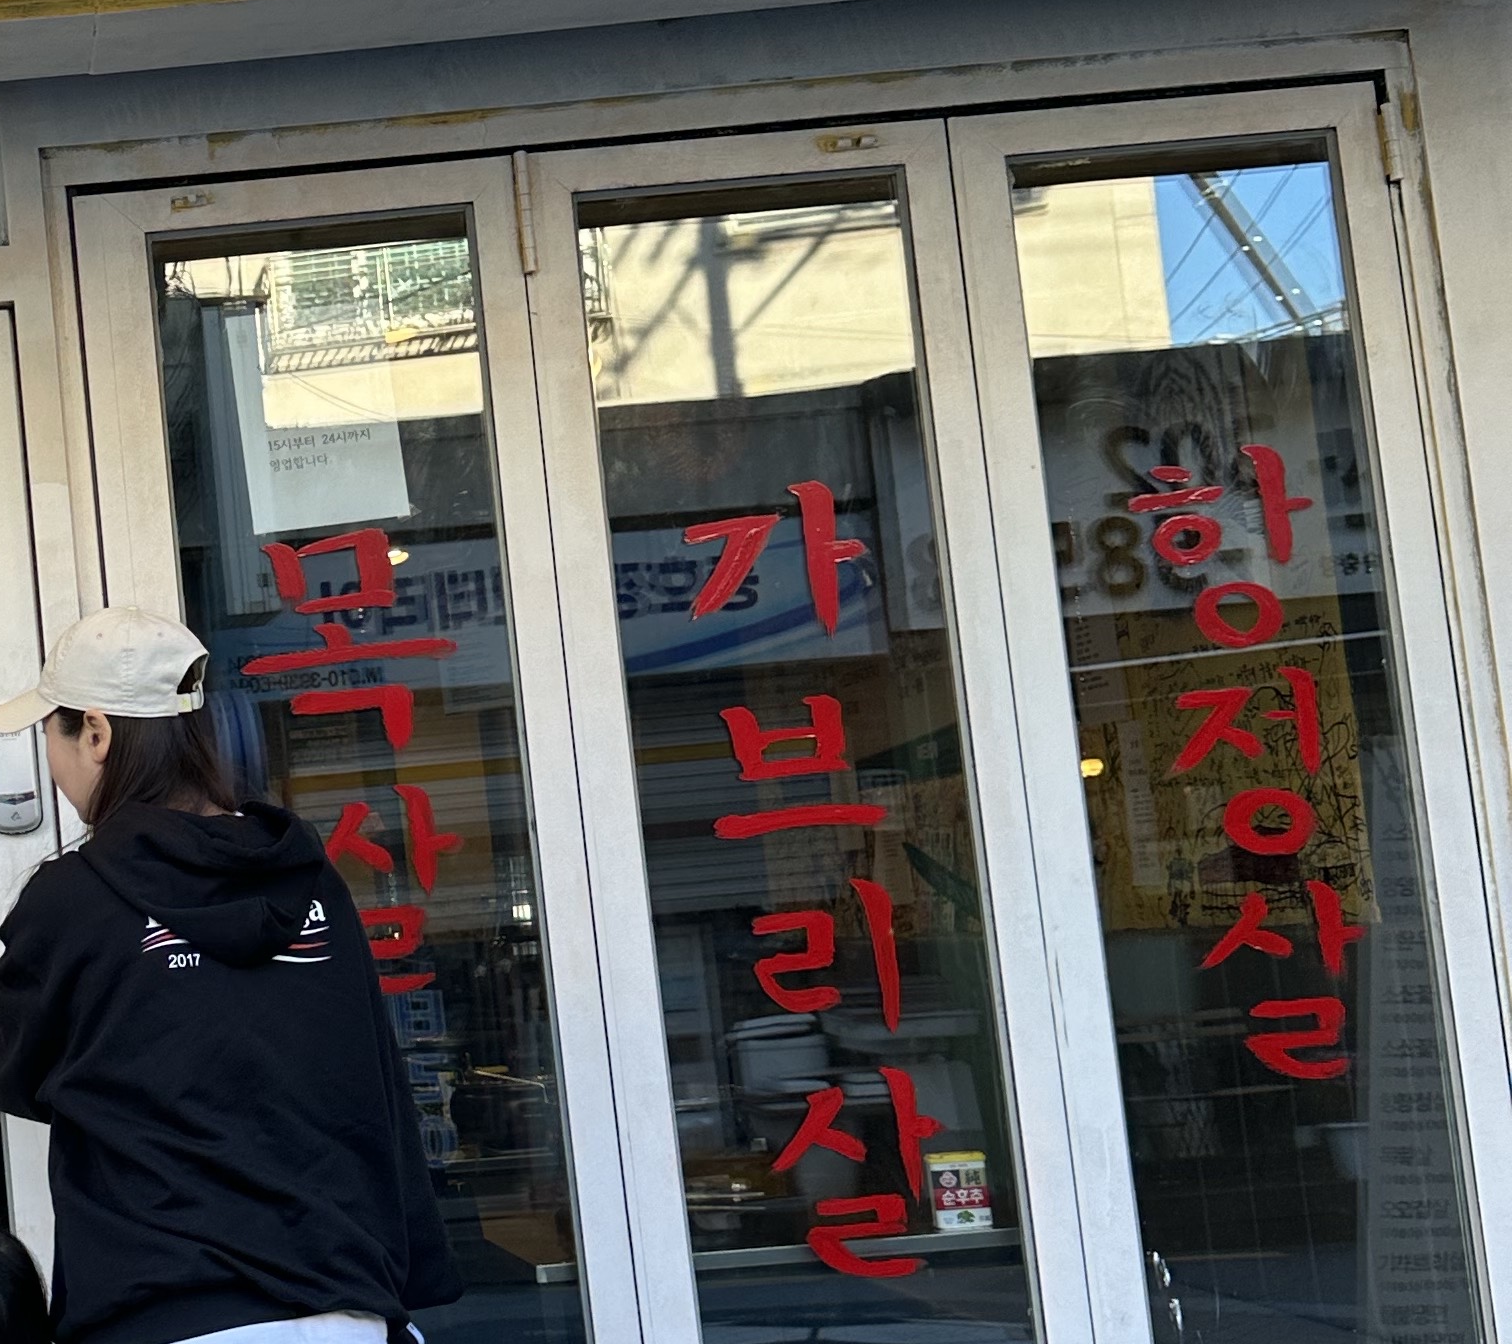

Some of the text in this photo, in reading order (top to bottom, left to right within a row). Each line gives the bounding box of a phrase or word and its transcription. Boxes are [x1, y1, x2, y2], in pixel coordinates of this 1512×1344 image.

[268, 428, 371, 451] 15시부터 24시까지
[243, 528, 463, 993] 목살
[685, 481, 943, 1277] 가브리살
[1129, 445, 1364, 1079] 항정살
[168, 954, 200, 968] 2017
[942, 1188, 984, 1206] 순후추
